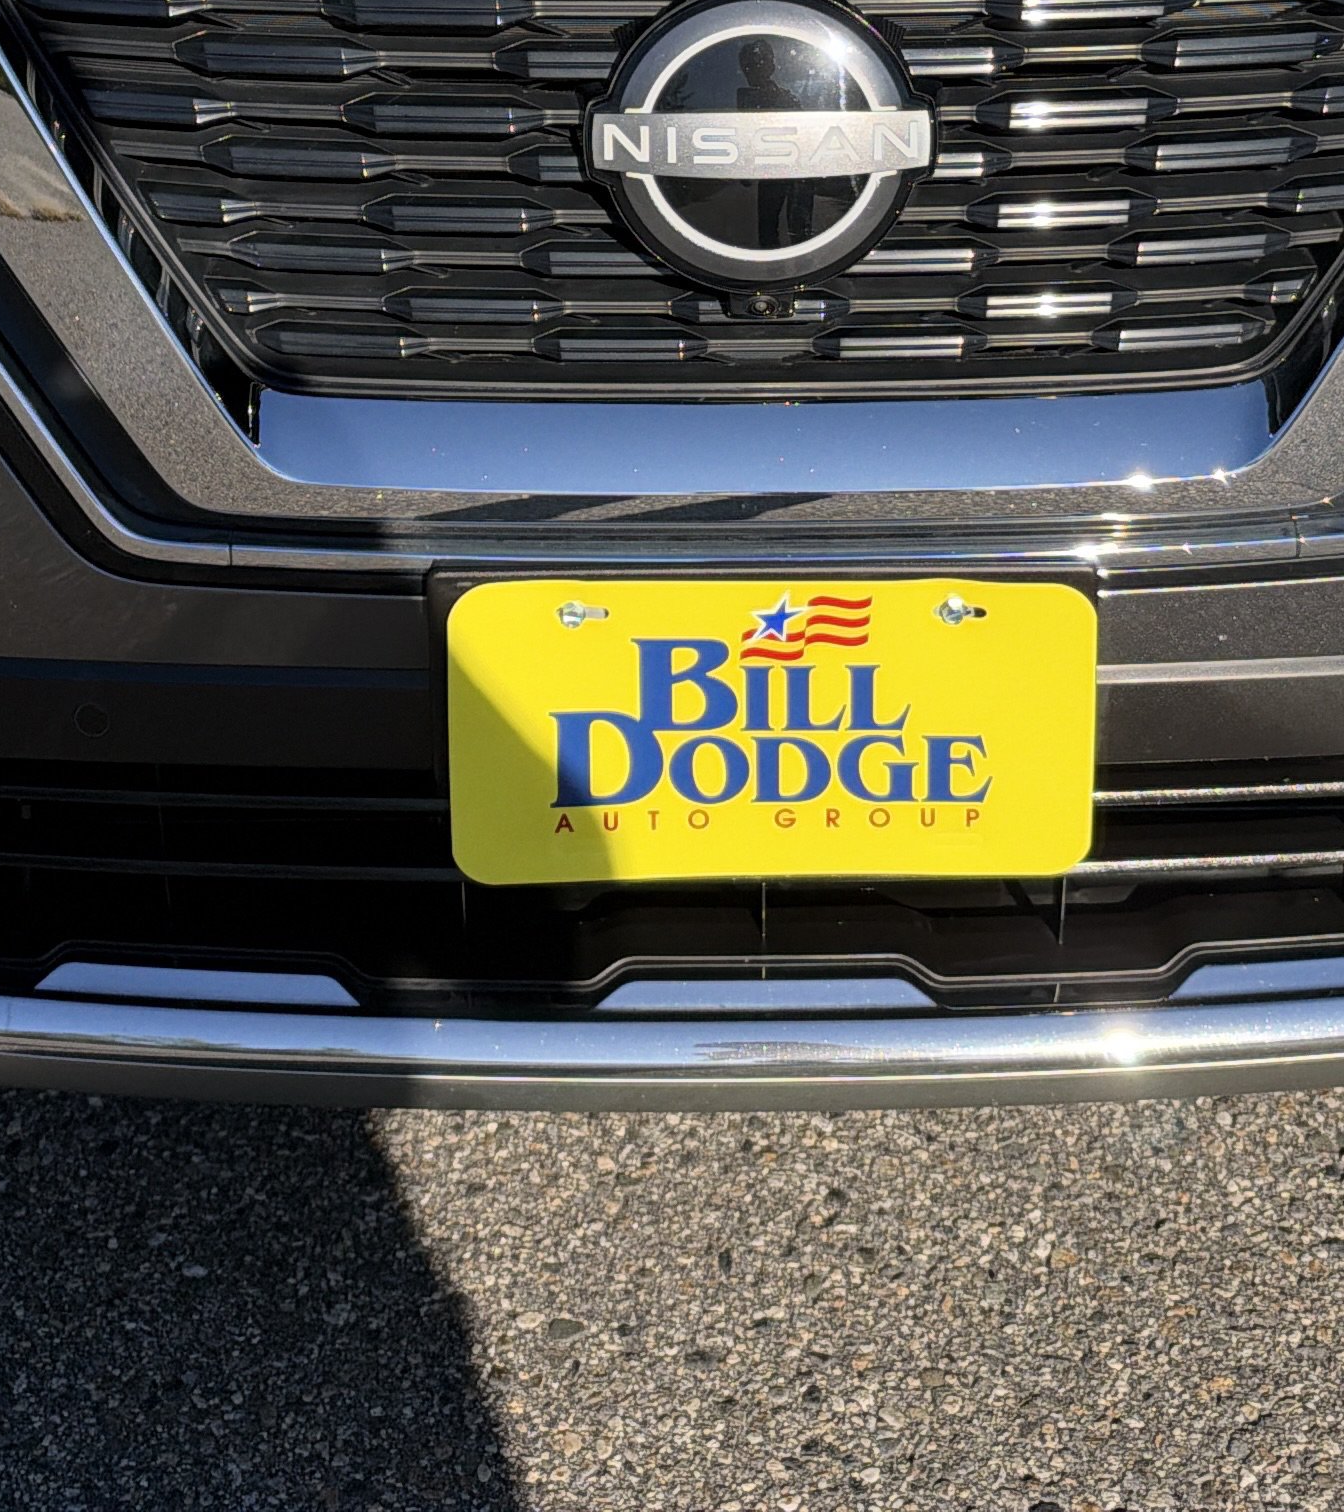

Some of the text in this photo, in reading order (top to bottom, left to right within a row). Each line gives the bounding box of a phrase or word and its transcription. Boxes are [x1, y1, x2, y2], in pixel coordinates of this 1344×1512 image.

[602, 120, 922, 165] NISSAN
[630, 637, 912, 733] BILL
[548, 710, 994, 809] DODGE
[554, 807, 982, 834] AUTO GROUP
